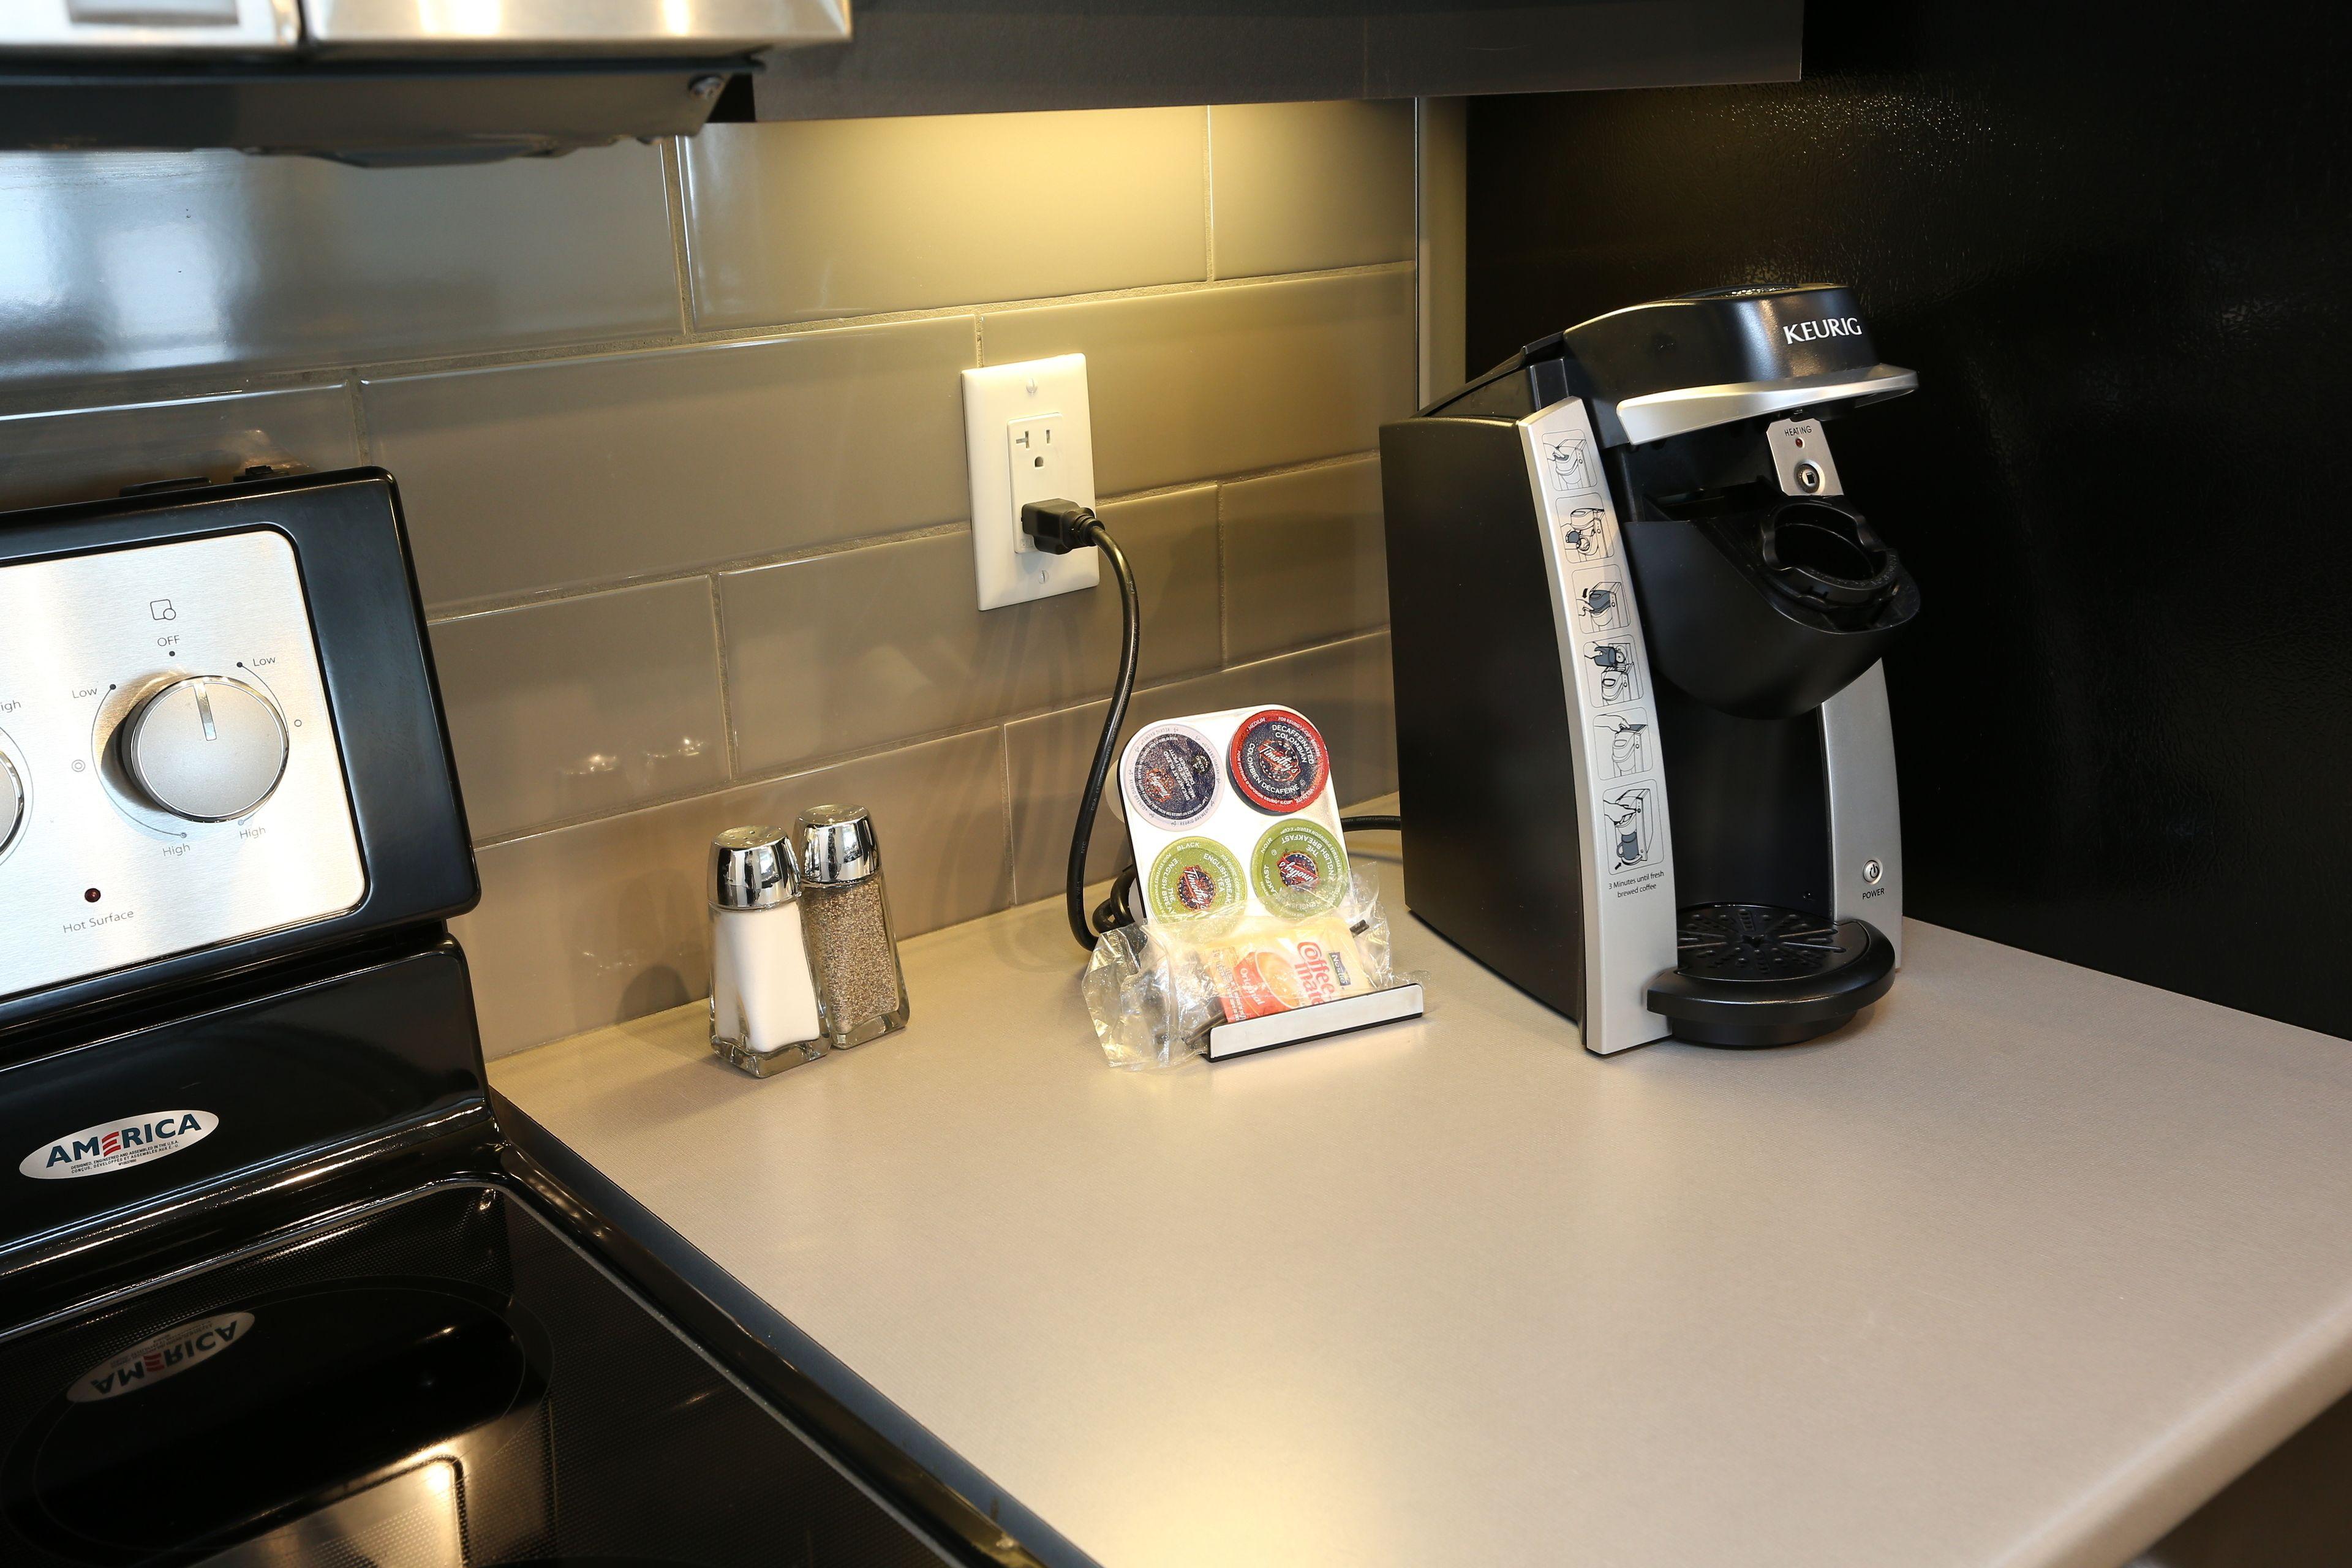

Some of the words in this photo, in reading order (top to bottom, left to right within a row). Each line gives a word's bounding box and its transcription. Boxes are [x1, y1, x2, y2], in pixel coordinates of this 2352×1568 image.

[1782, 317, 1863, 345] KEURIG
[1784, 425, 1812, 437] HEATING
[157, 635, 180, 647] OFF
[252, 655, 276, 667] Low
[72, 687, 97, 699] Low
[0, 699, 21, 713] igh
[1248, 717, 1265, 731] MEDIUM
[1272, 725, 1314, 764] DECAFFEINATED
[1275, 732, 1307, 763] COLOMBIAN
[1163, 751, 1175, 769] BLEND
[1169, 749, 1178, 763] PETIT
[1247, 743, 1262, 784] COLOMBIEN
[1259, 744, 1298, 773] Timothy's
[1175, 763, 1183, 772] DU
[1173, 770, 1189, 801] BREAKFAST
[239, 826, 266, 839] High
[162, 843, 191, 857] High
[1177, 842, 1199, 851] BLACK
[1261, 837, 1273, 854] NOIR
[1281, 834, 1322, 849] BREAKFAST
[1162, 858, 1178, 889] ENGLISH
[1204, 853, 1227, 877] ENGLISH
[1279, 861, 1315, 882] imothy's
[1613, 878, 1636, 888] Minutes
[1637, 874, 1649, 883] until
[1650, 870, 1664, 879] fresh
[1617, 887, 1638, 898] brewed
[1639, 883, 1657, 892] coffee
[1862, 888, 1885, 900] POWER
[62, 920, 86, 933] Hot
[89, 910, 134, 927] Surface
[46, 1114, 202, 1168] AMERICA
[94, 1155, 119, 1164] ENGINEERED
[129, 1147, 153, 1155] ASSEMBLED
